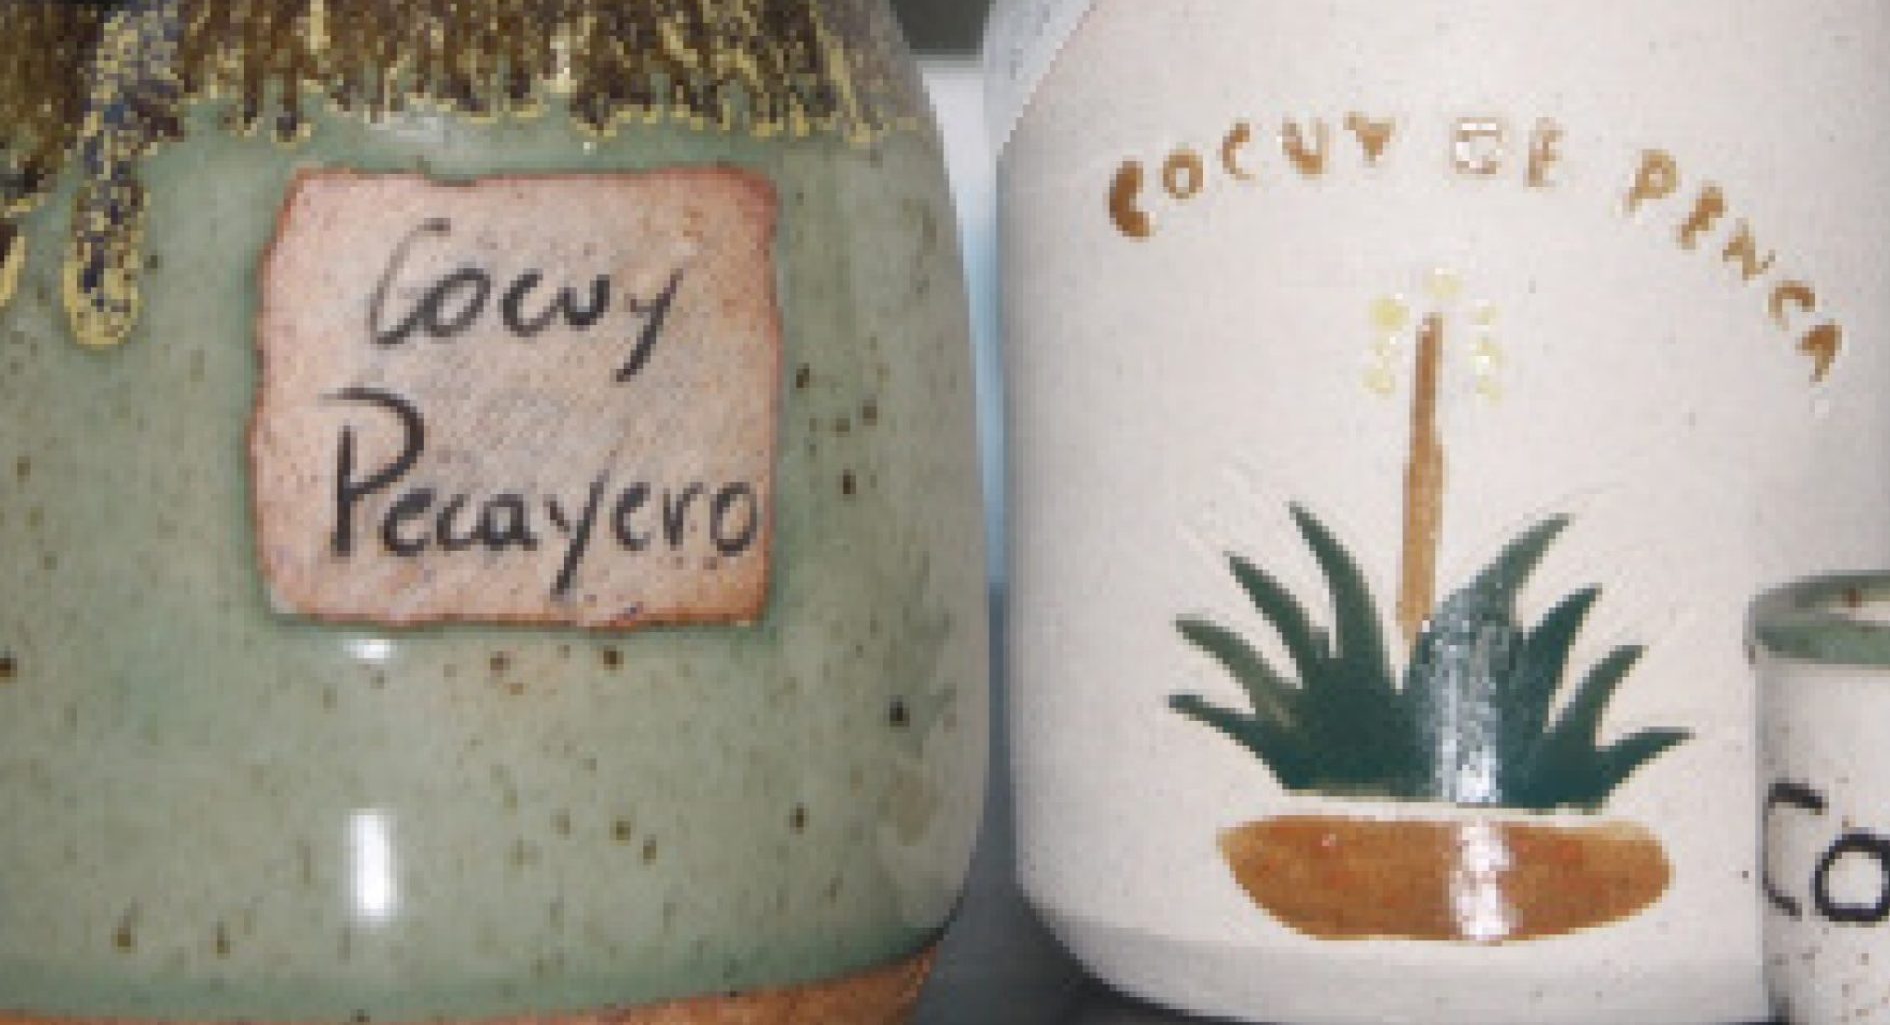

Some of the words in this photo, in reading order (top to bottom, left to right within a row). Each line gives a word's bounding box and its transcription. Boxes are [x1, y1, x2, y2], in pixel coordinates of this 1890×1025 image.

[1108, 111, 1396, 239] COCUY
[367, 217, 683, 382] Cocuy
[319, 387, 757, 599] Pecayero
